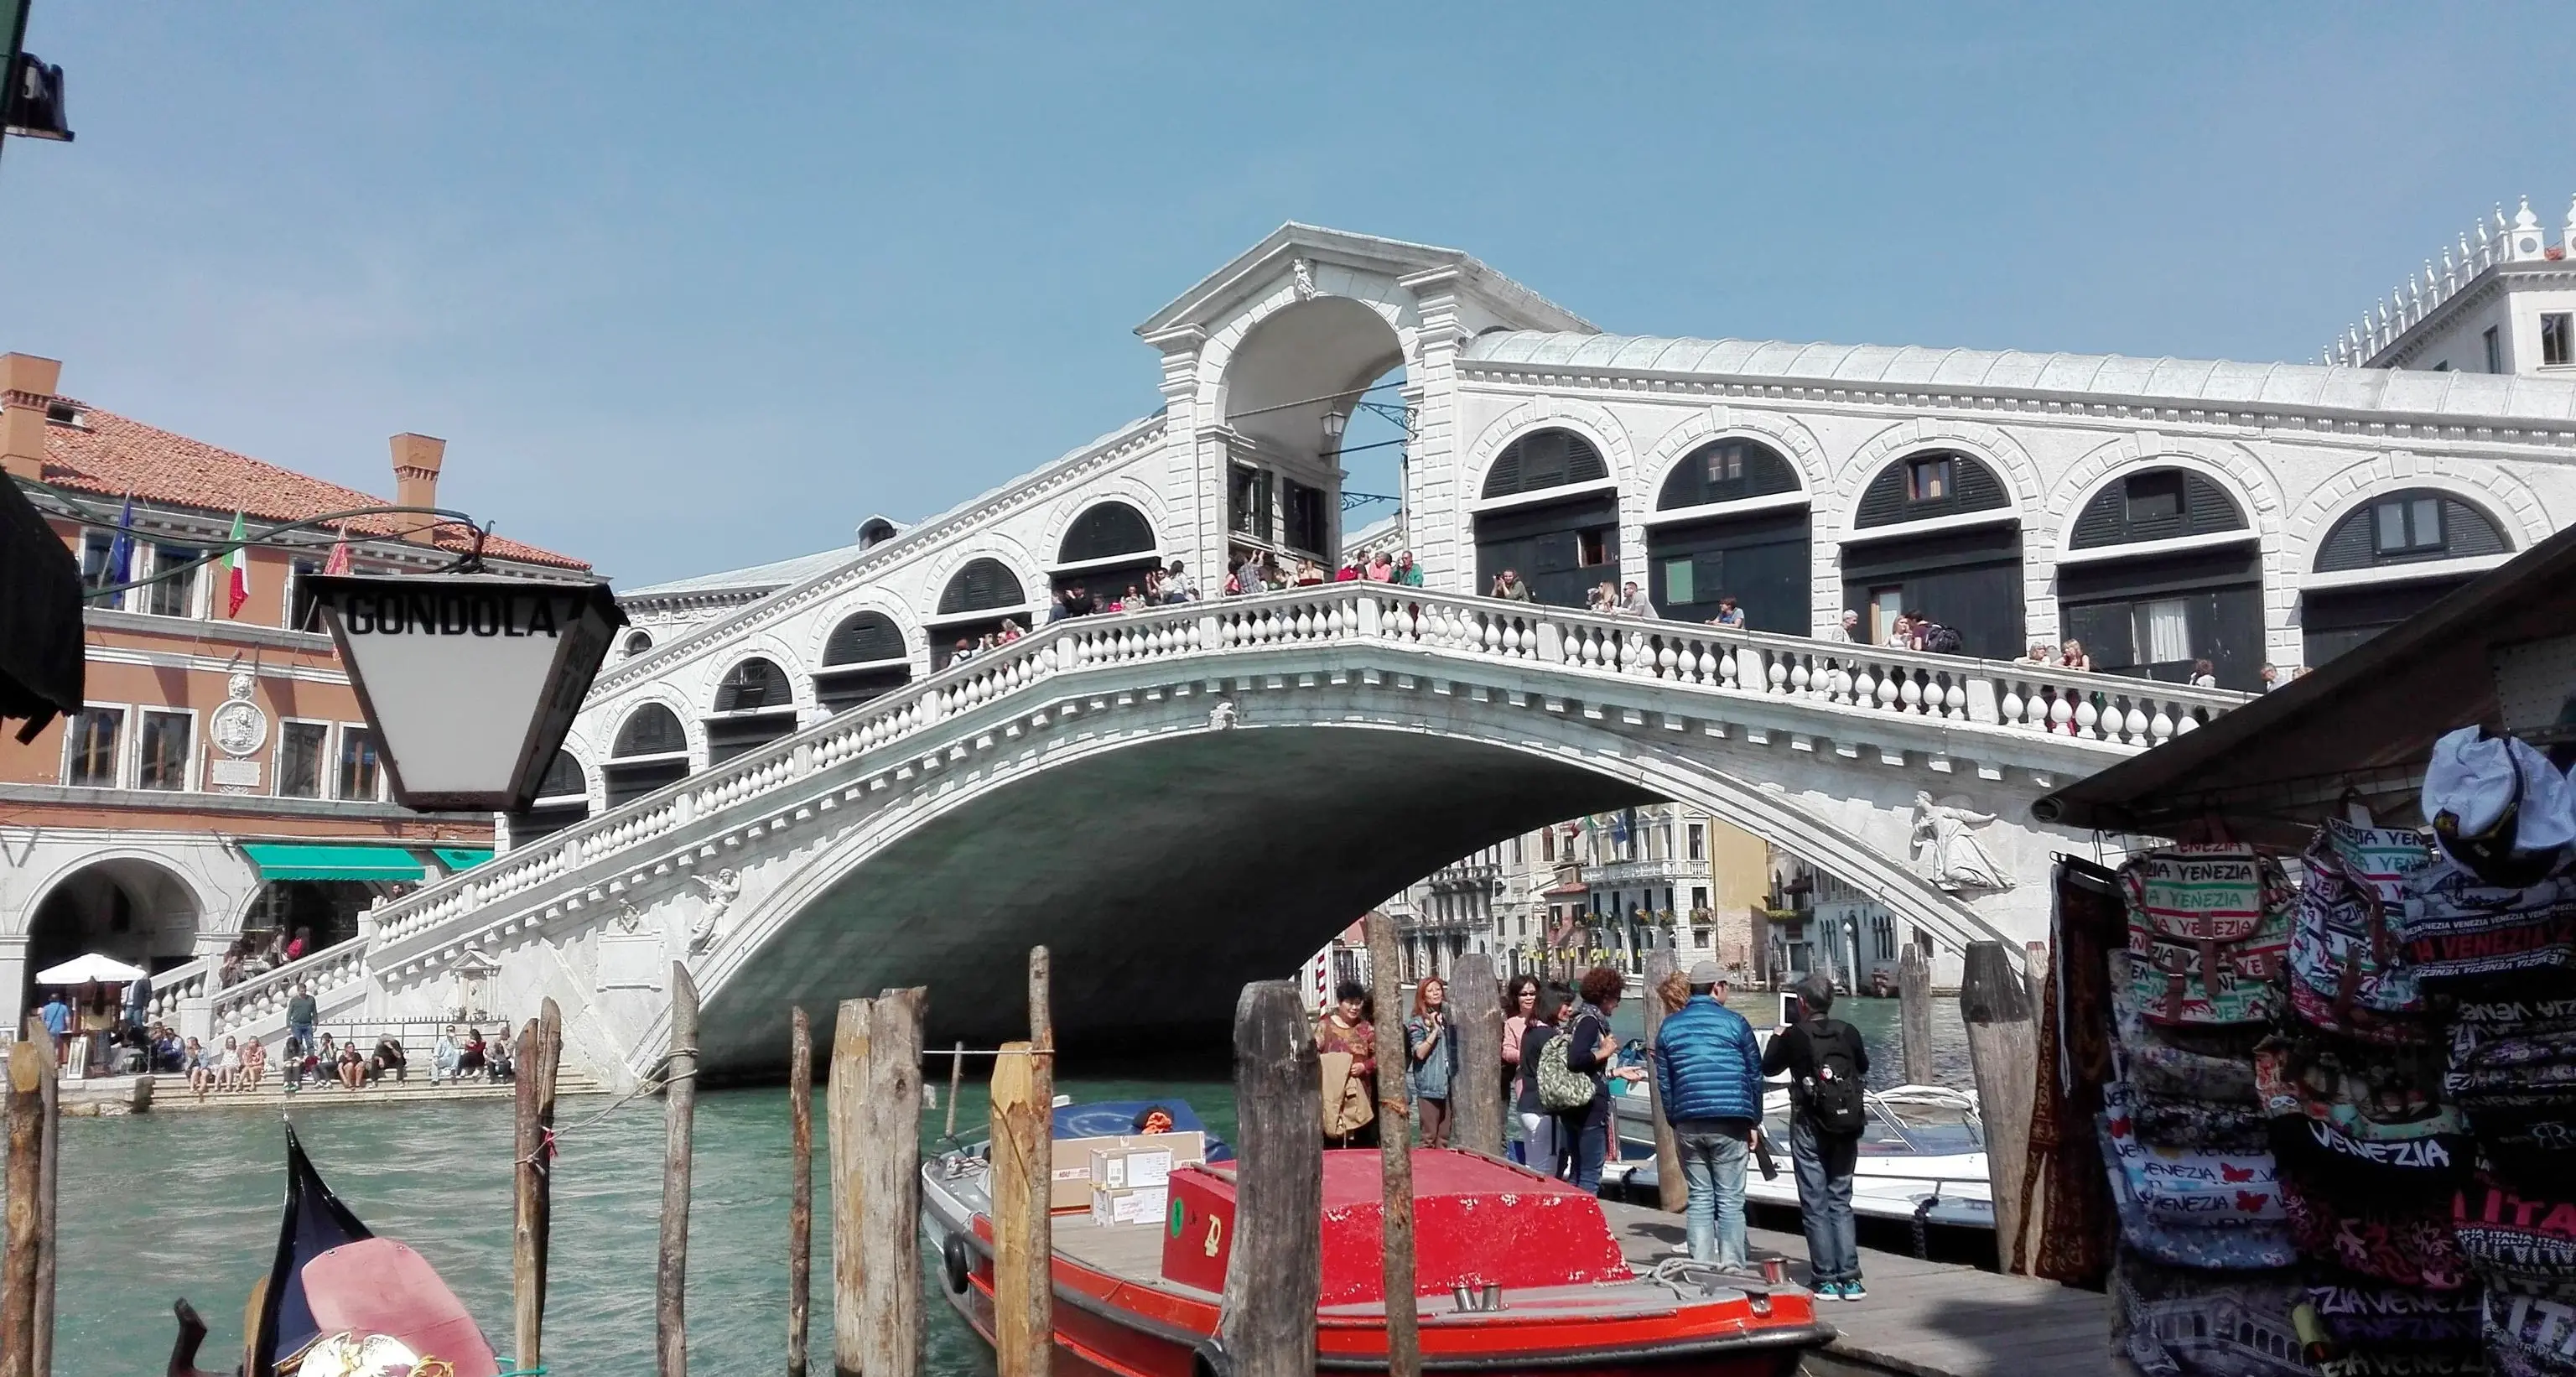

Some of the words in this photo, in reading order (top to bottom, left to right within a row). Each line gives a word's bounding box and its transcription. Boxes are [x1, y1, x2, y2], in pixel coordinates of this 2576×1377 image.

[345, 593, 557, 638] GONDOLA
[2178, 863, 2252, 881] VENEZIA
[2169, 891, 2242, 908] VENEZIA
[2182, 920, 2251, 937] VEEZIA
[2452, 917, 2488, 929] VENEZIA
[2490, 911, 2526, 923] VENEZIA
[2441, 925, 2547, 961] VENEZIA
[2308, 1120, 2452, 1168] VENEZIA
[2153, 1194, 2229, 1213] VENEZIA
[2488, 1230, 2533, 1239] ITALIA
